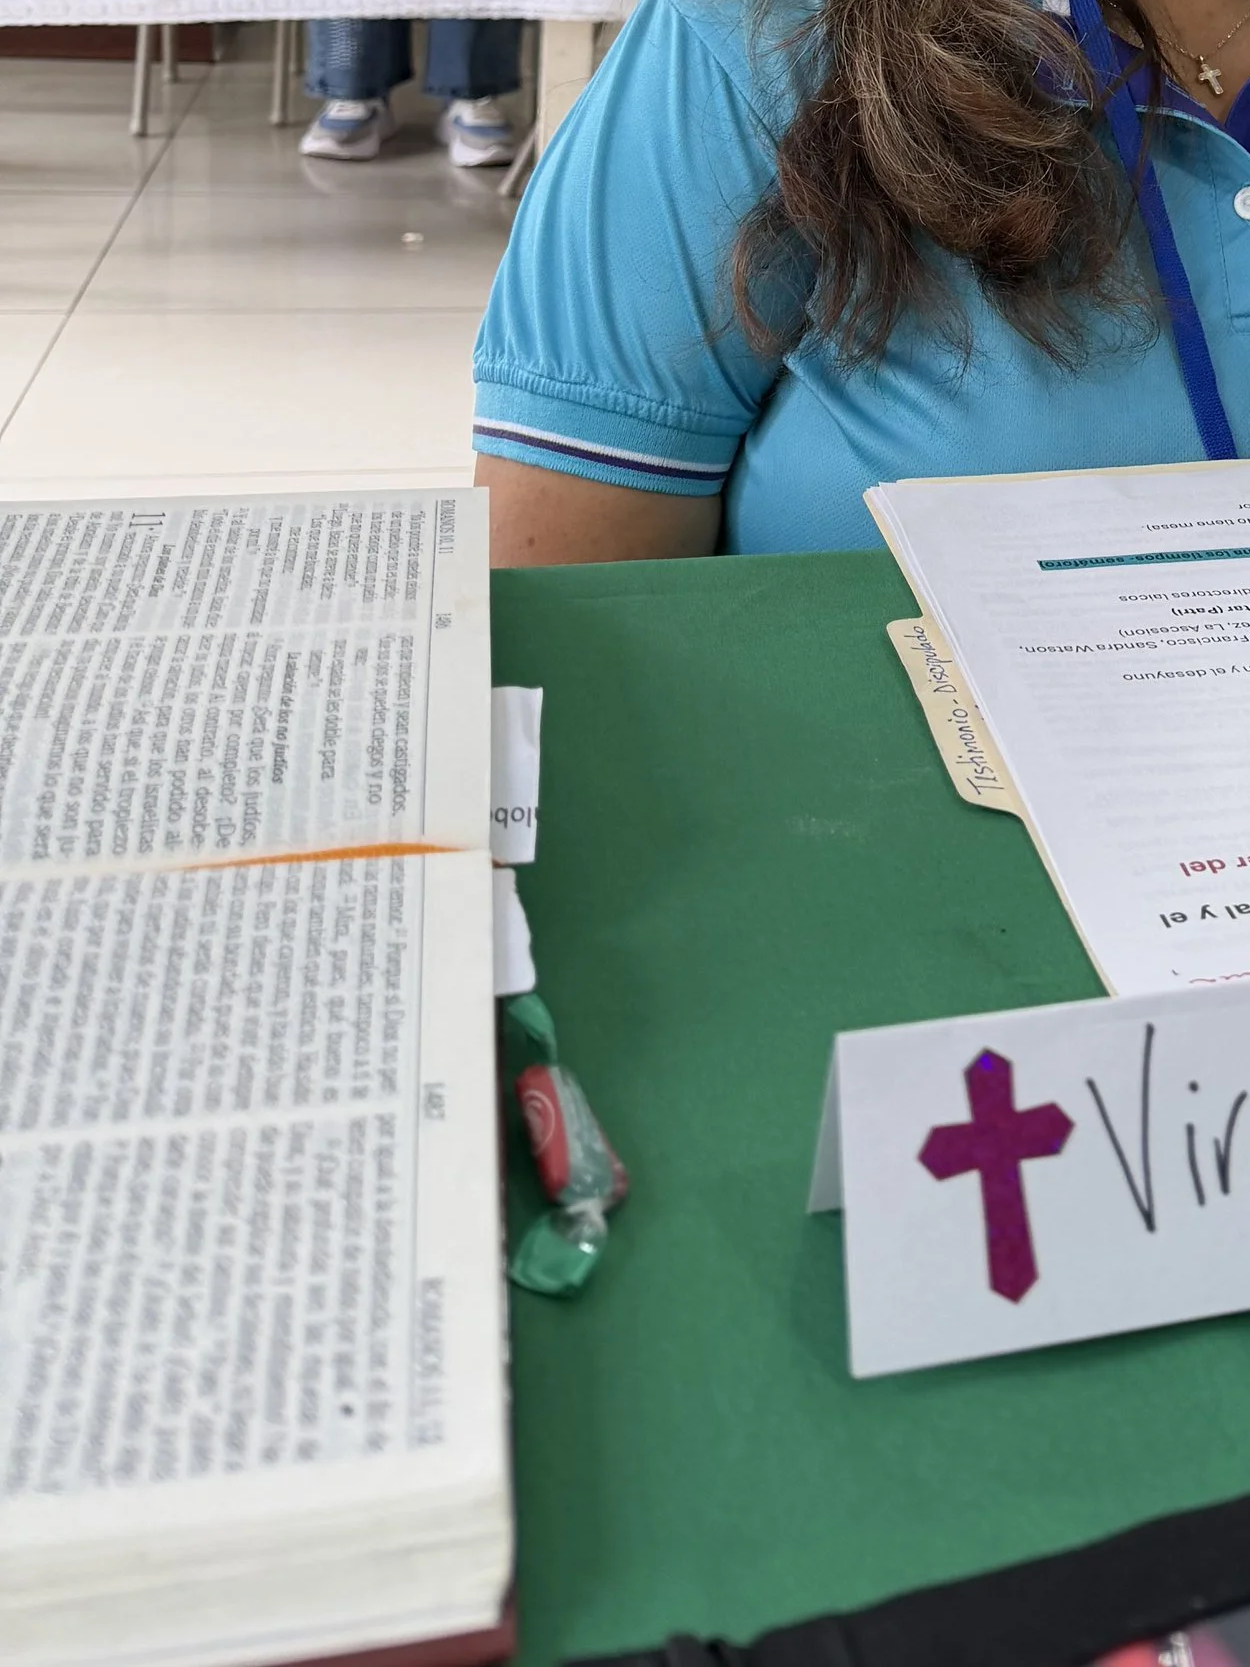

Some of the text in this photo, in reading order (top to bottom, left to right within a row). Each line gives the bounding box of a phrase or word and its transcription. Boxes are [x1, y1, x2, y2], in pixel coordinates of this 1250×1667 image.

[438, 499, 455, 533] ROMANOS
[1122, 669, 1207, 681] desayuno
[1209, 667, 1227, 677] el
[276, 726, 290, 741] no
[248, 738, 266, 761] que
[319, 715, 343, 780] doble para
[271, 742, 289, 784] judíos
[391, 738, 412, 816] castigados.
[367, 783, 383, 805] no
[1179, 858, 1226, 877] del
[1159, 911, 1188, 929] el
[1200, 904, 1218, 920] y
